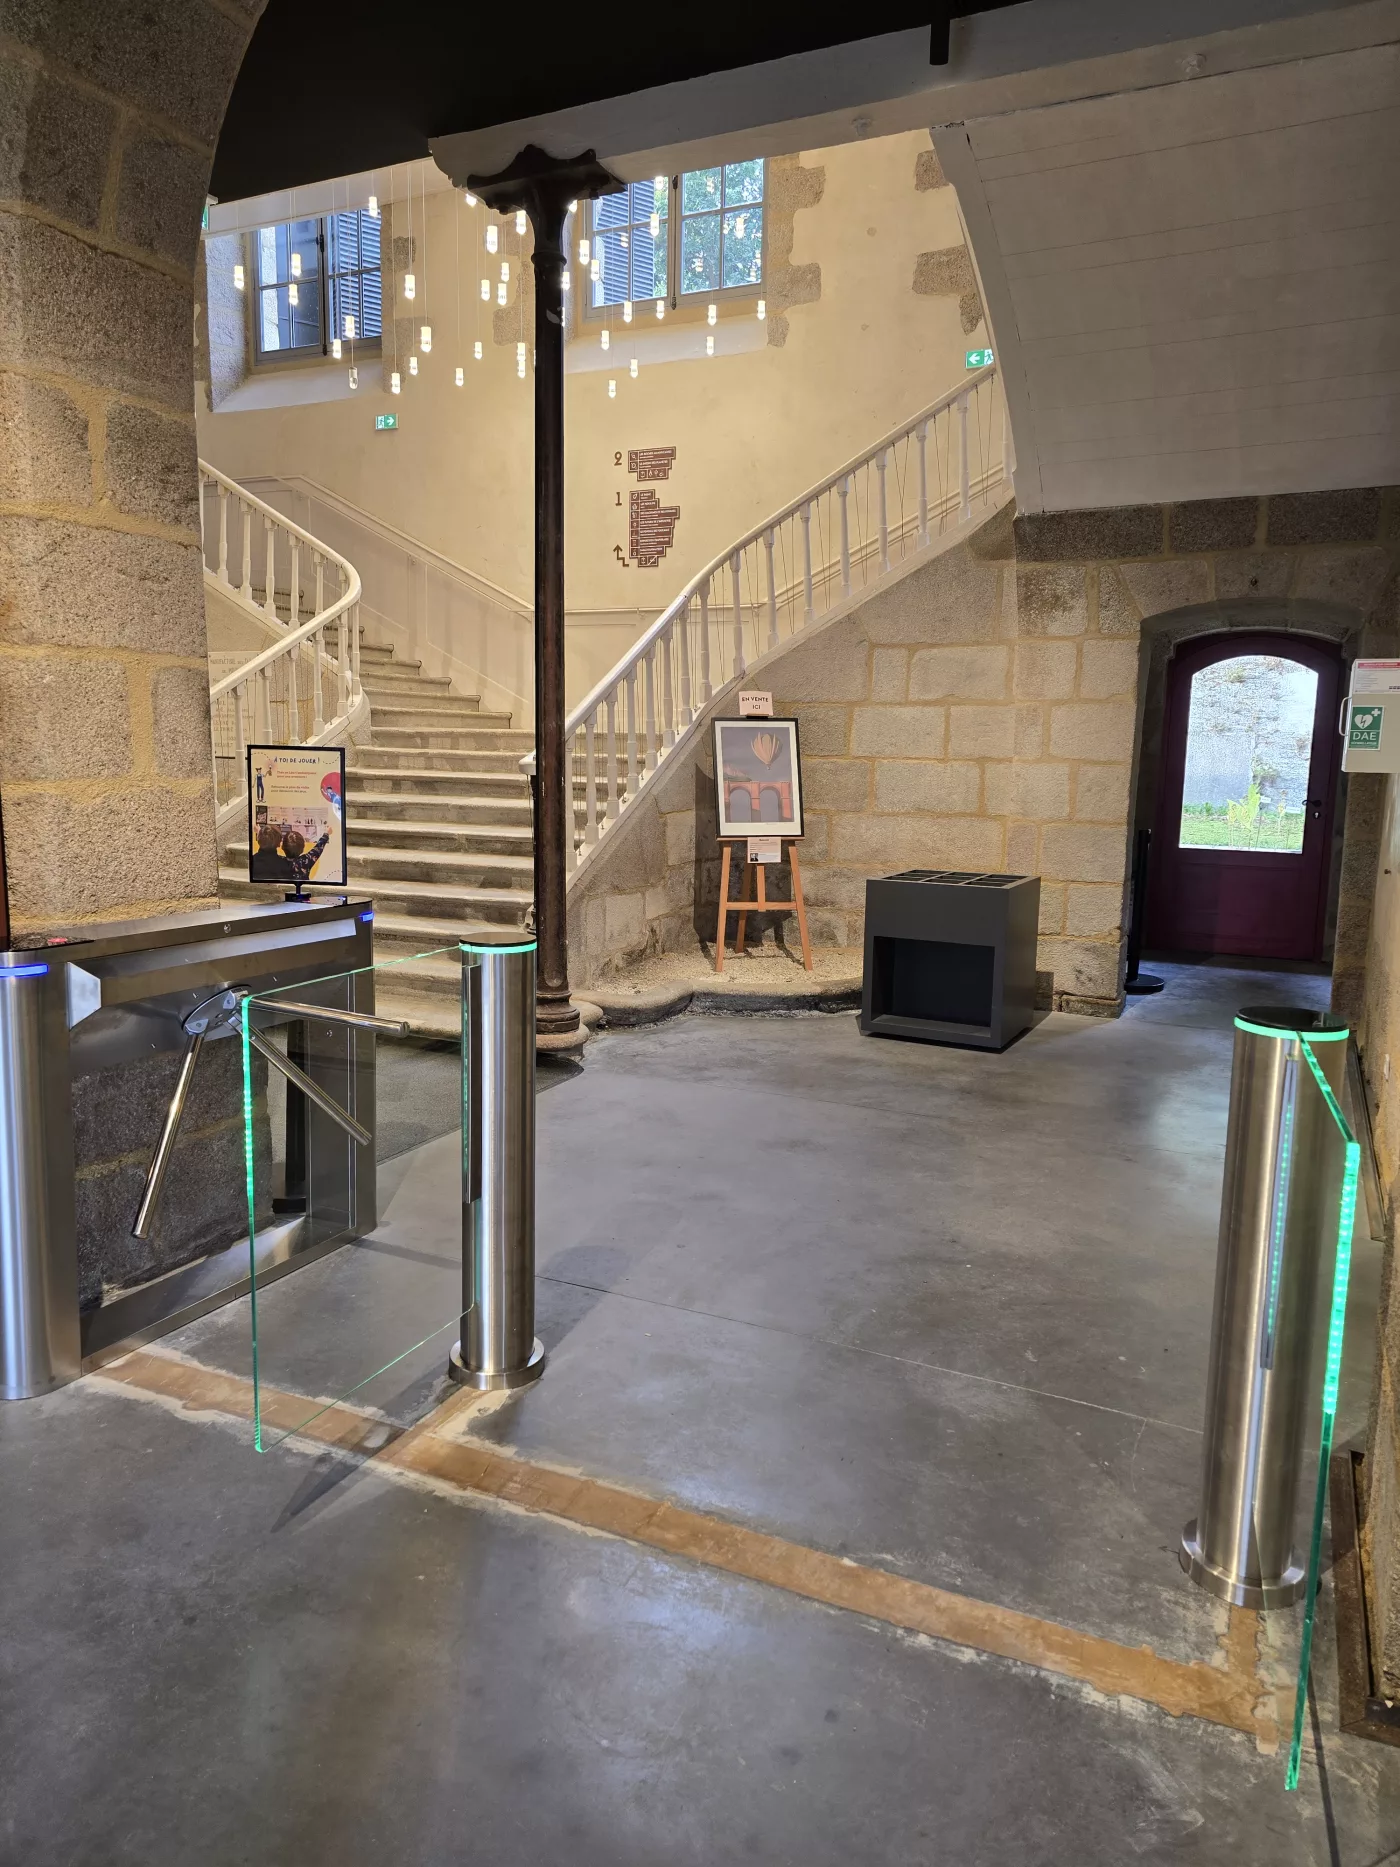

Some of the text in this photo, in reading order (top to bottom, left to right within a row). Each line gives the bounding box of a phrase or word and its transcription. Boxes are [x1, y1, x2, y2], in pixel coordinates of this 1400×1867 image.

[614, 451, 622, 466] 2
[615, 491, 622, 506] 1
[1353, 732, 1377, 741] DAE
